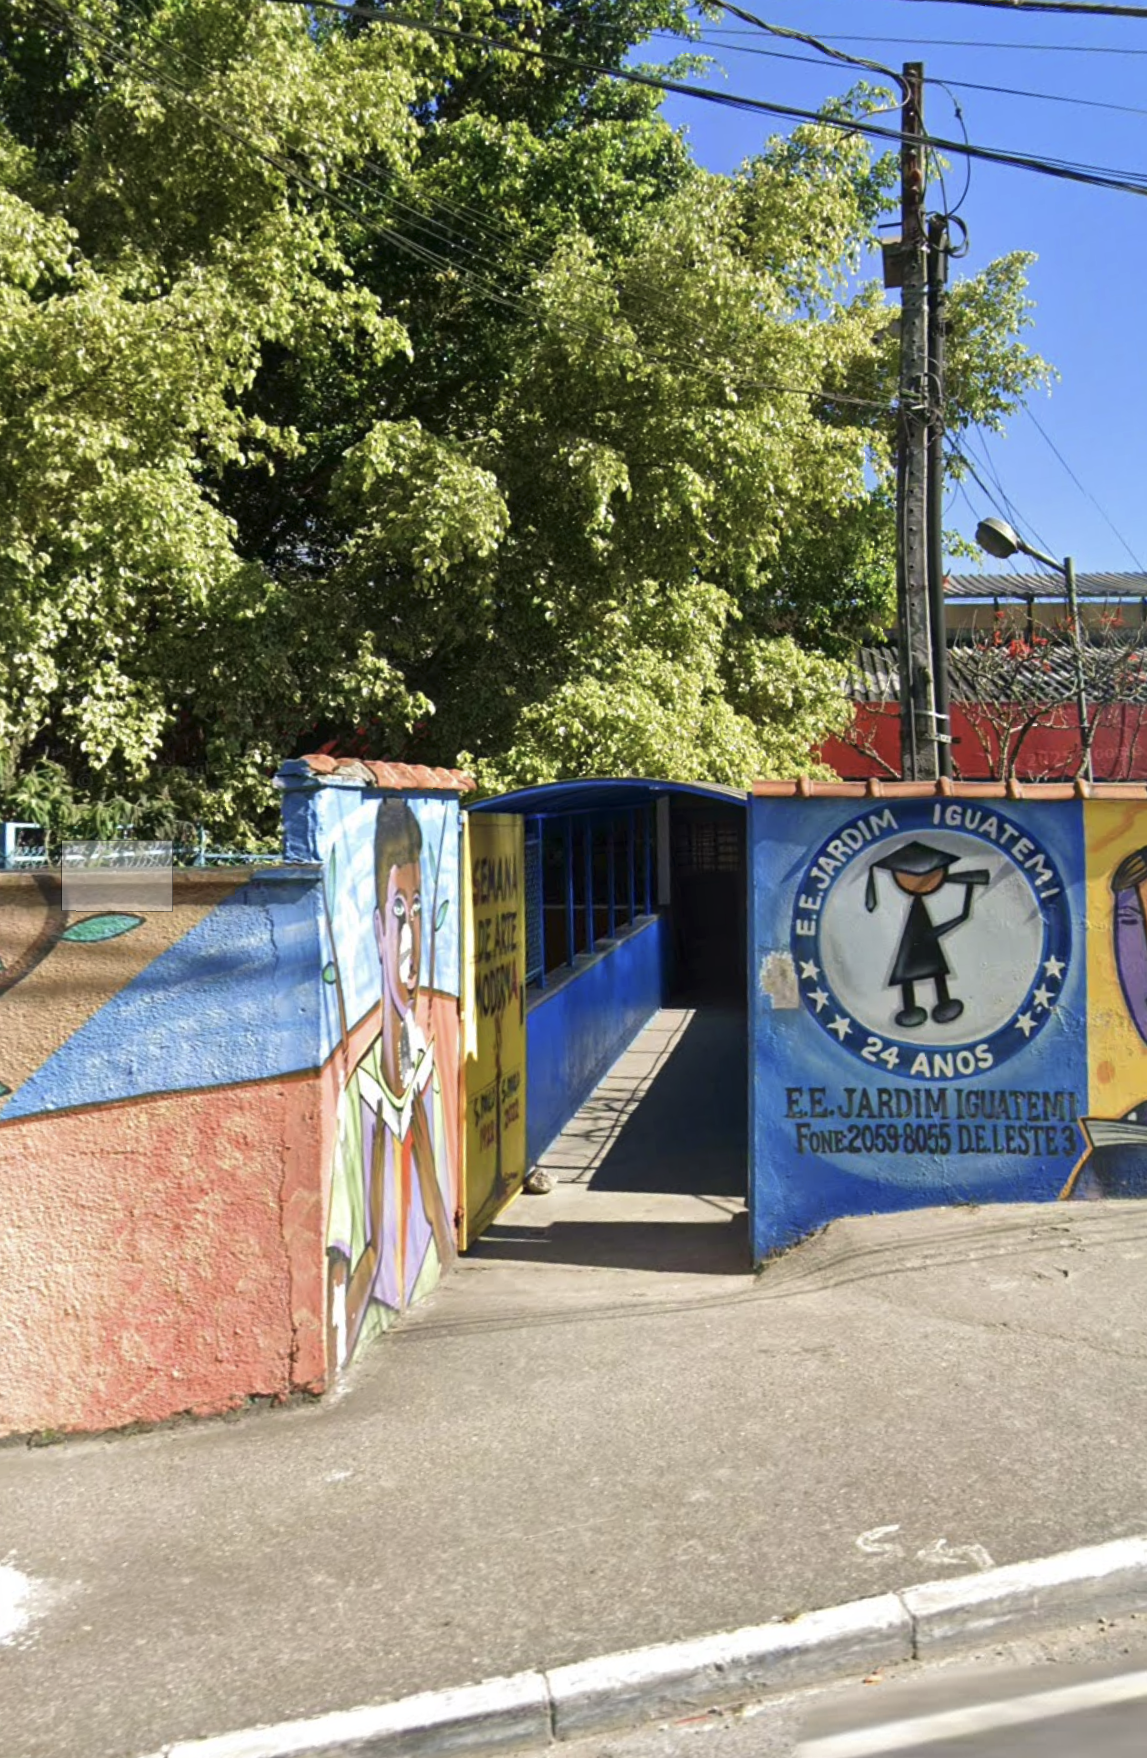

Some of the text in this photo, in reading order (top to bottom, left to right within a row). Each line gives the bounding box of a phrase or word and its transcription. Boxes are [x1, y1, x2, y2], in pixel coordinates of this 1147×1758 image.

[932, 803, 1059, 900] IGUATEMI
[473, 854, 518, 907] SEMANA
[861, 1037, 993, 1079] 24 ANOS
[954, 1088, 1079, 1122] IGUATEMI
[1062, 1125, 1077, 1156] 3
